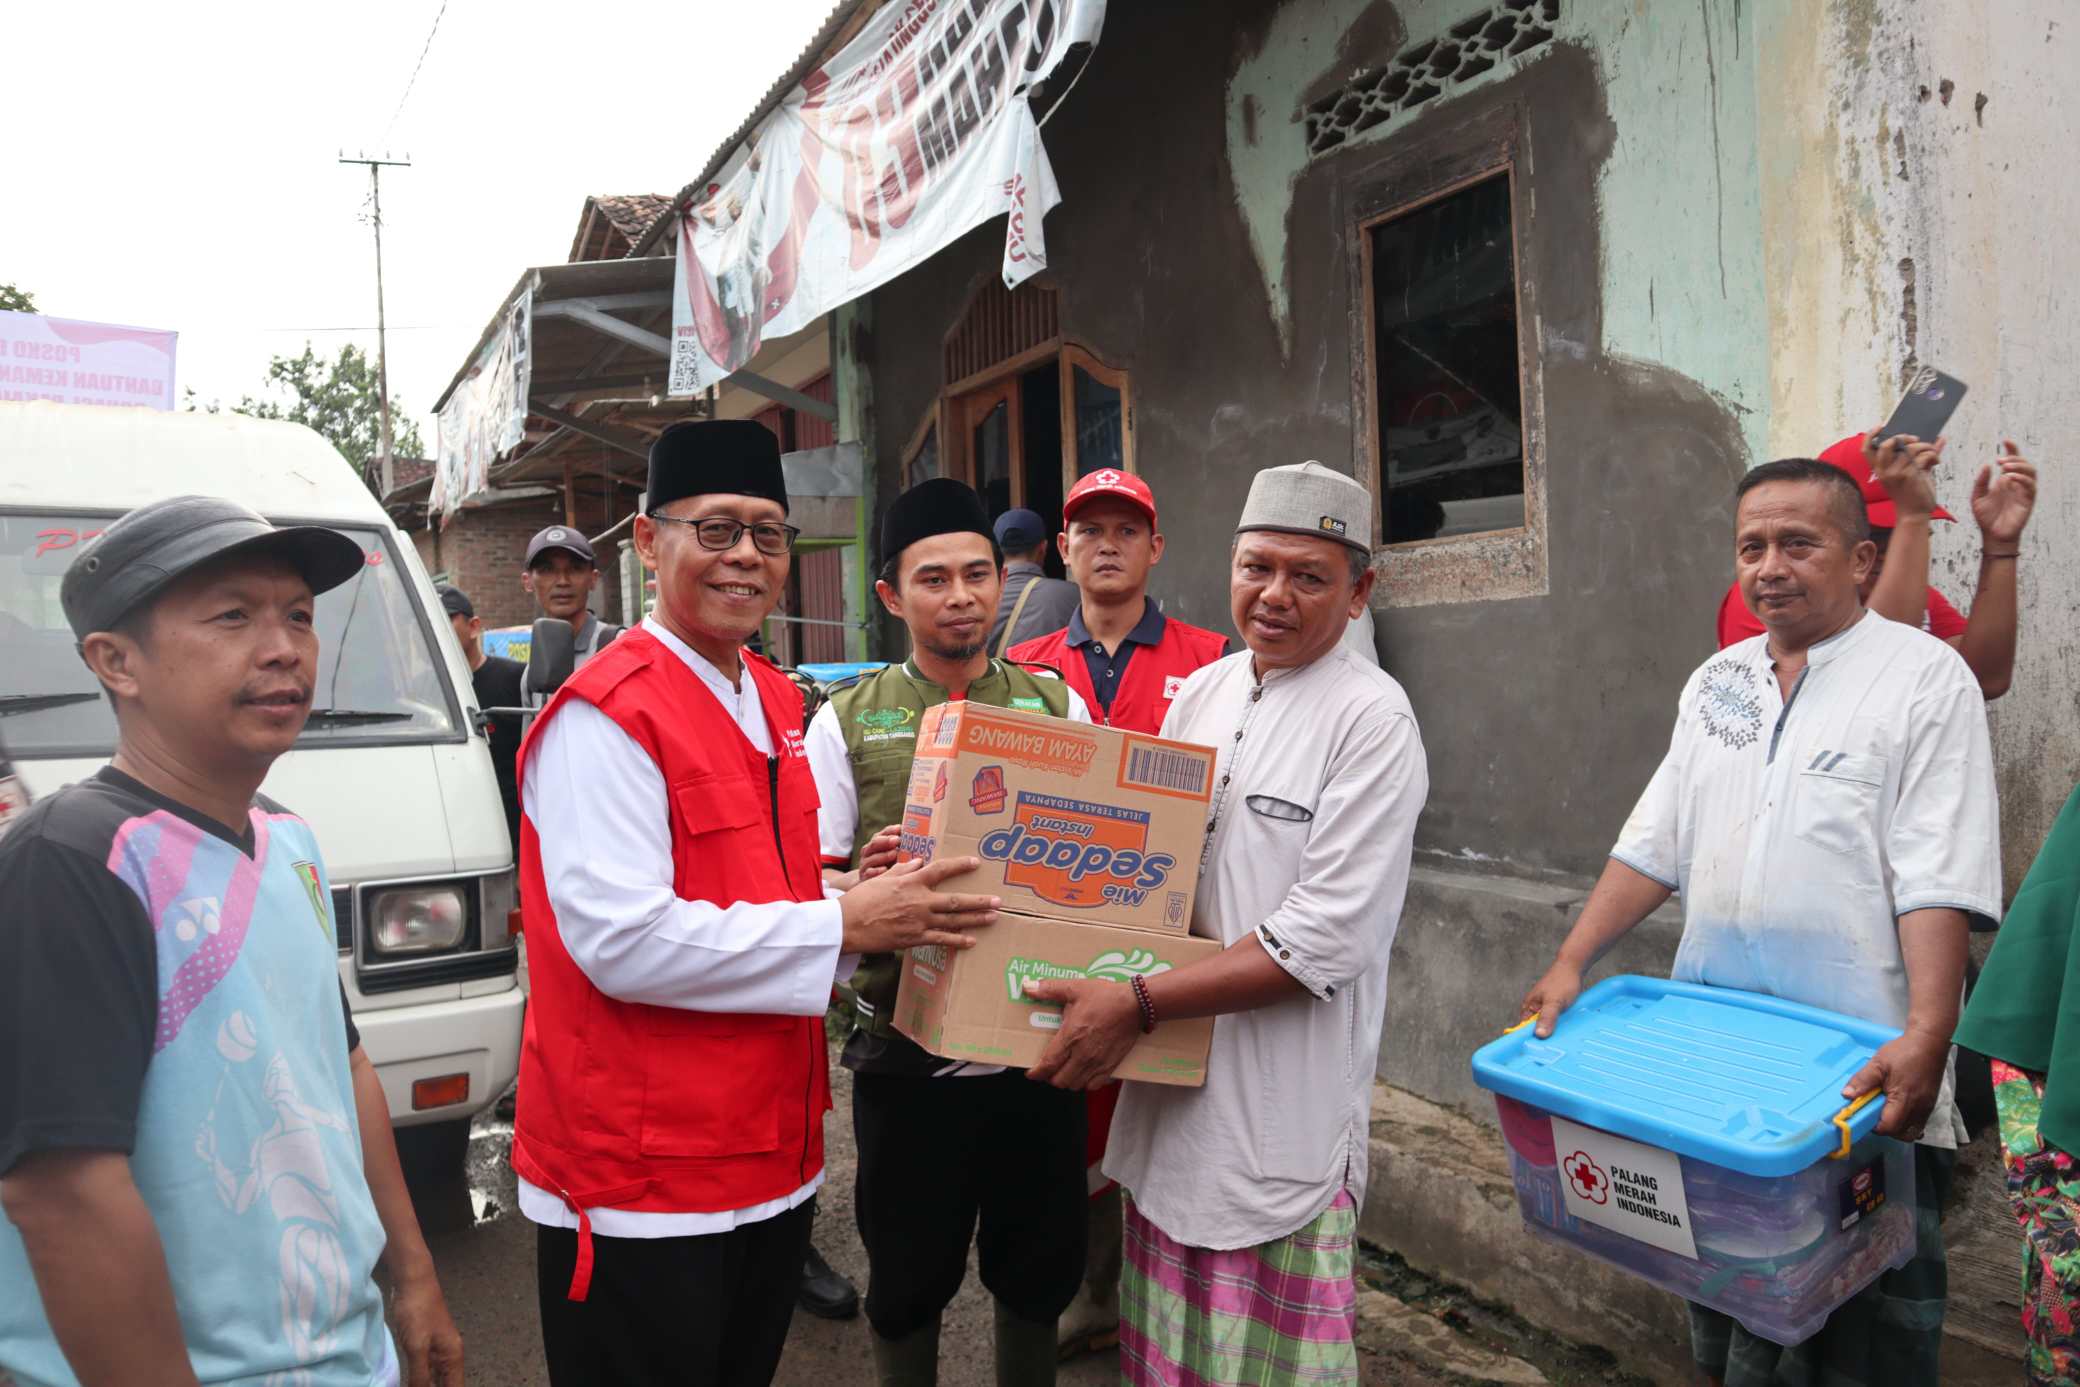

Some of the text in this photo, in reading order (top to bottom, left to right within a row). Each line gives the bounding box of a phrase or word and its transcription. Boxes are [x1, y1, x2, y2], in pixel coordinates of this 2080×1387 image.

[968, 725, 1097, 763] AYAM BAWANG
[1025, 794, 1143, 821] JELAS TERASA SEDAPNYA
[1031, 815, 1095, 838] Instant
[979, 824, 1177, 889] Sedaap
[1101, 883, 1148, 906] Mie
[1010, 959, 1080, 979] Air Minum
[1610, 1165, 1658, 1191] PALANG
[1613, 1181, 1657, 1206] MERAH
[1616, 1197, 1682, 1229] INDONESIA
